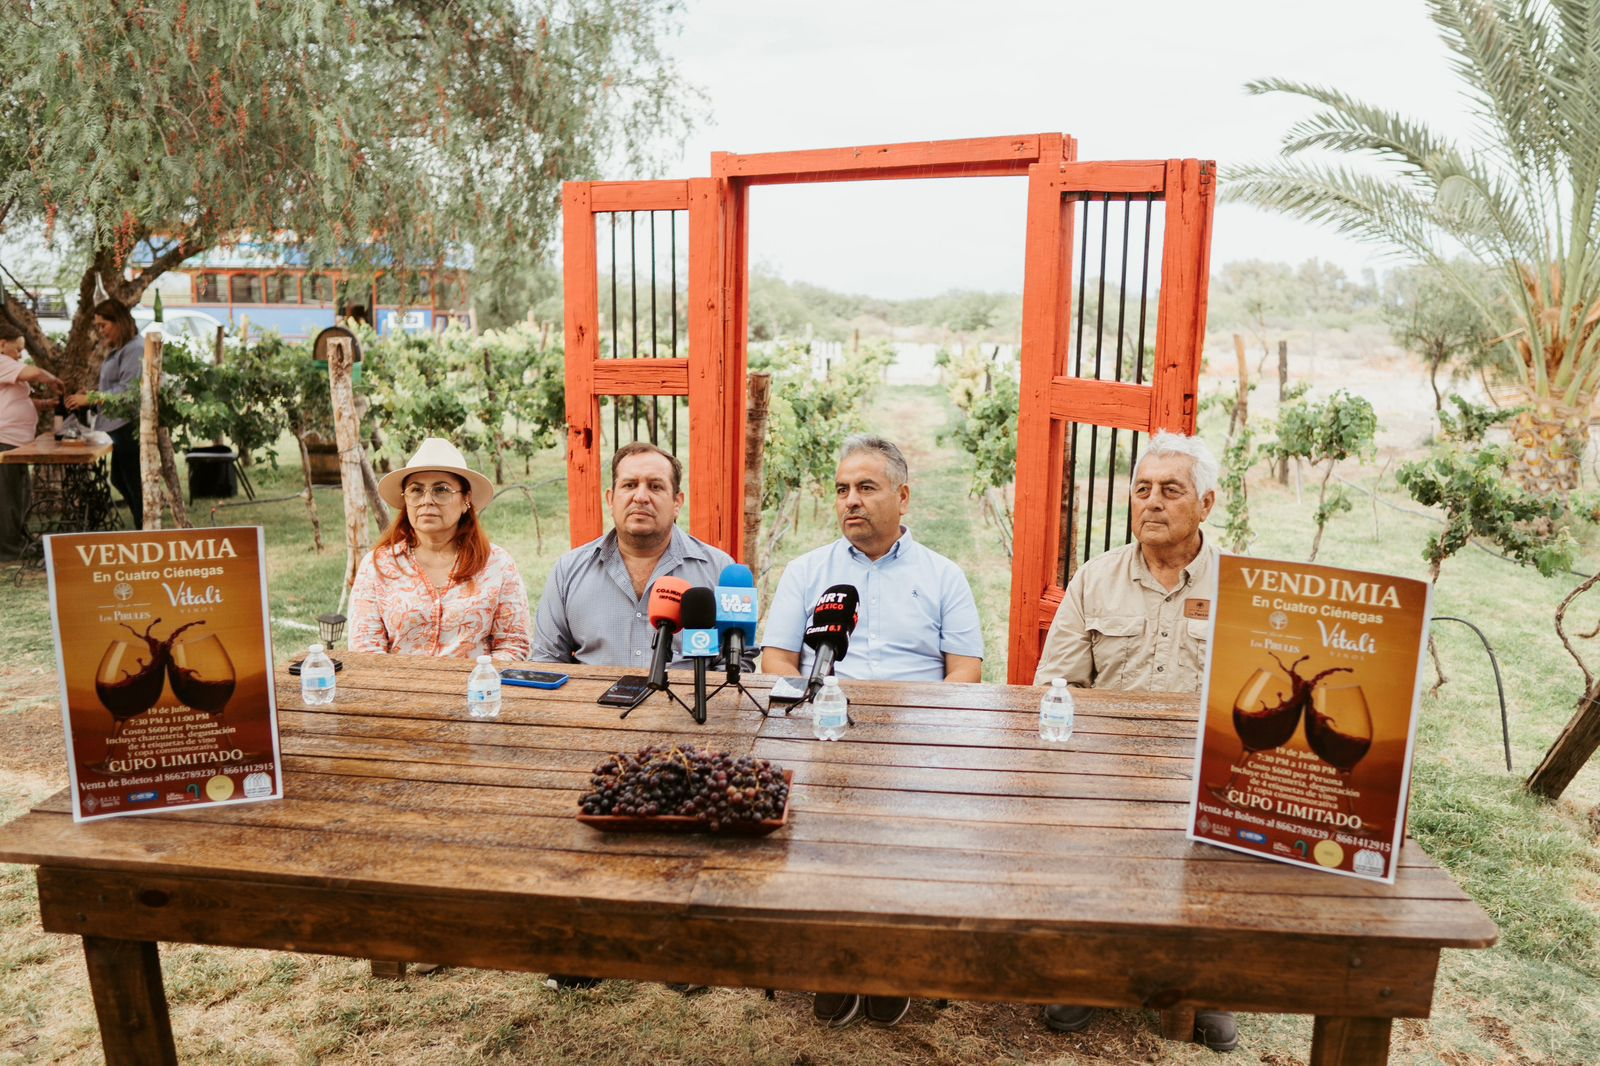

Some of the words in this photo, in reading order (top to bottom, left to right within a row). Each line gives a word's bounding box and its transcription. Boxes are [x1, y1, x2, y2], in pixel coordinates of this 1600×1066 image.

[75, 537, 238, 567] VENDIMIA
[93, 571, 112, 583] En
[115, 570, 160, 582] Cuatro
[163, 566, 224, 579] Ciénegas
[161, 581, 224, 607] Vitali
[656, 588, 682, 598] COAHUI
[1240, 567, 1402, 609] VENDIMIA
[721, 593, 741, 603] LA
[721, 601, 752, 613] VOZ
[1252, 595, 1270, 608] En
[1273, 597, 1318, 615] Cuatro
[1320, 605, 1384, 624] Ciénegas
[806, 625, 829, 635] Canal
[828, 624, 842, 632] 6.1
[1316, 619, 1377, 654] Vitali
[148, 707, 157, 715] 19
[159, 706, 169, 714] de
[170, 705, 191, 713] Julio
[122, 728, 147, 736] Costo
[169, 726, 184, 734] por
[185, 722, 218, 731] Persona
[105, 737, 137, 745] Incluye
[147, 739, 185, 750] etiquetas
[134, 749, 154, 758] copa
[1286, 748, 1298, 757] de
[109, 757, 157, 773] CUPO
[161, 748, 244, 768] LIMITADO
[1247, 760, 1271, 772] Costo
[80, 781, 107, 791] Venta
[107, 779, 119, 787] de
[121, 776, 153, 786] Boletos
[154, 774, 163, 782] al
[1198, 801, 1222, 815] Venta
[1222, 807, 1234, 818] de
[1265, 818, 1276, 829] al
[1228, 789, 1273, 811] CUPO
[1276, 800, 1362, 829] LIMITADO
